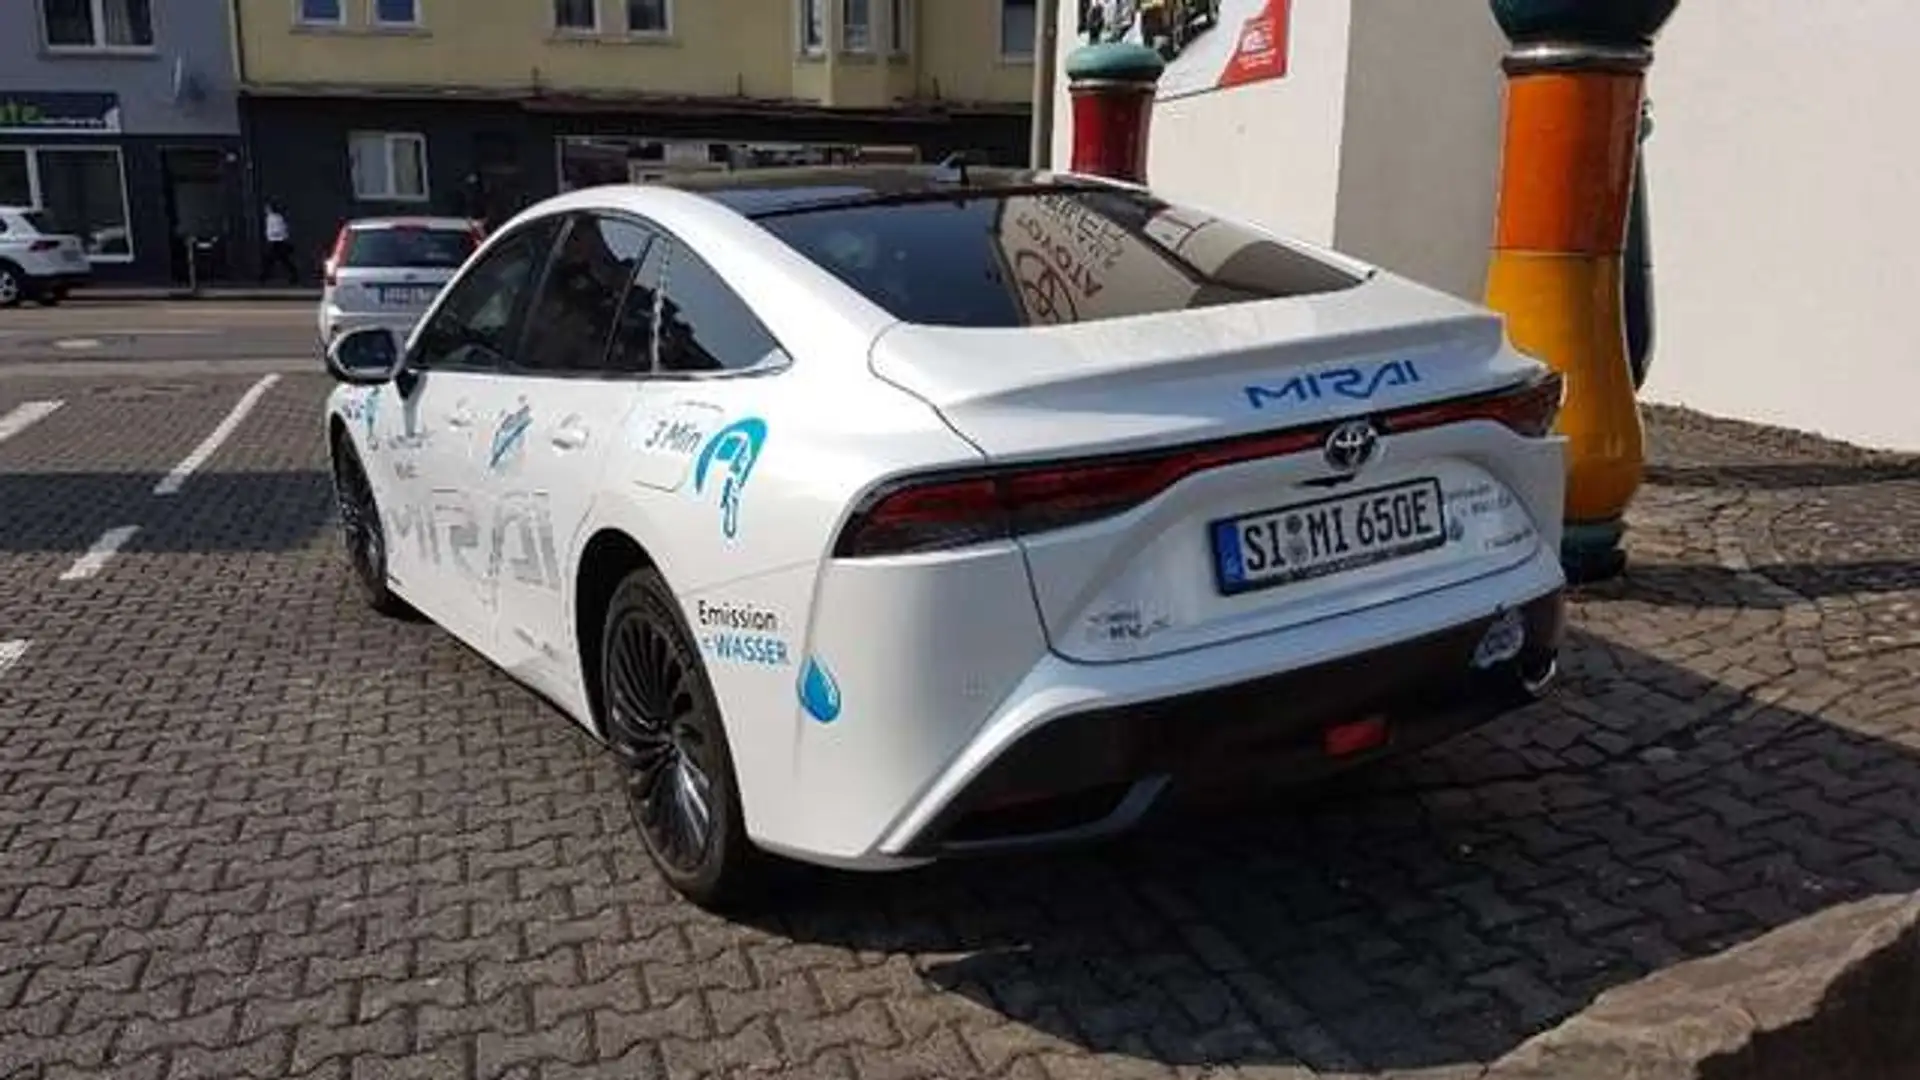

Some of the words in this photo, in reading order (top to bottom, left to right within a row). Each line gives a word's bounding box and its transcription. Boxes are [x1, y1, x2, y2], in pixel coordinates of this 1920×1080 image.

[1245, 360, 1419, 408] MIRAI
[1244, 521, 1285, 570] SI
[1306, 507, 1349, 556] MI
[1356, 490, 1432, 544] 650E
[698, 600, 777, 630] Emission
[714, 634, 789, 665] WASSER
